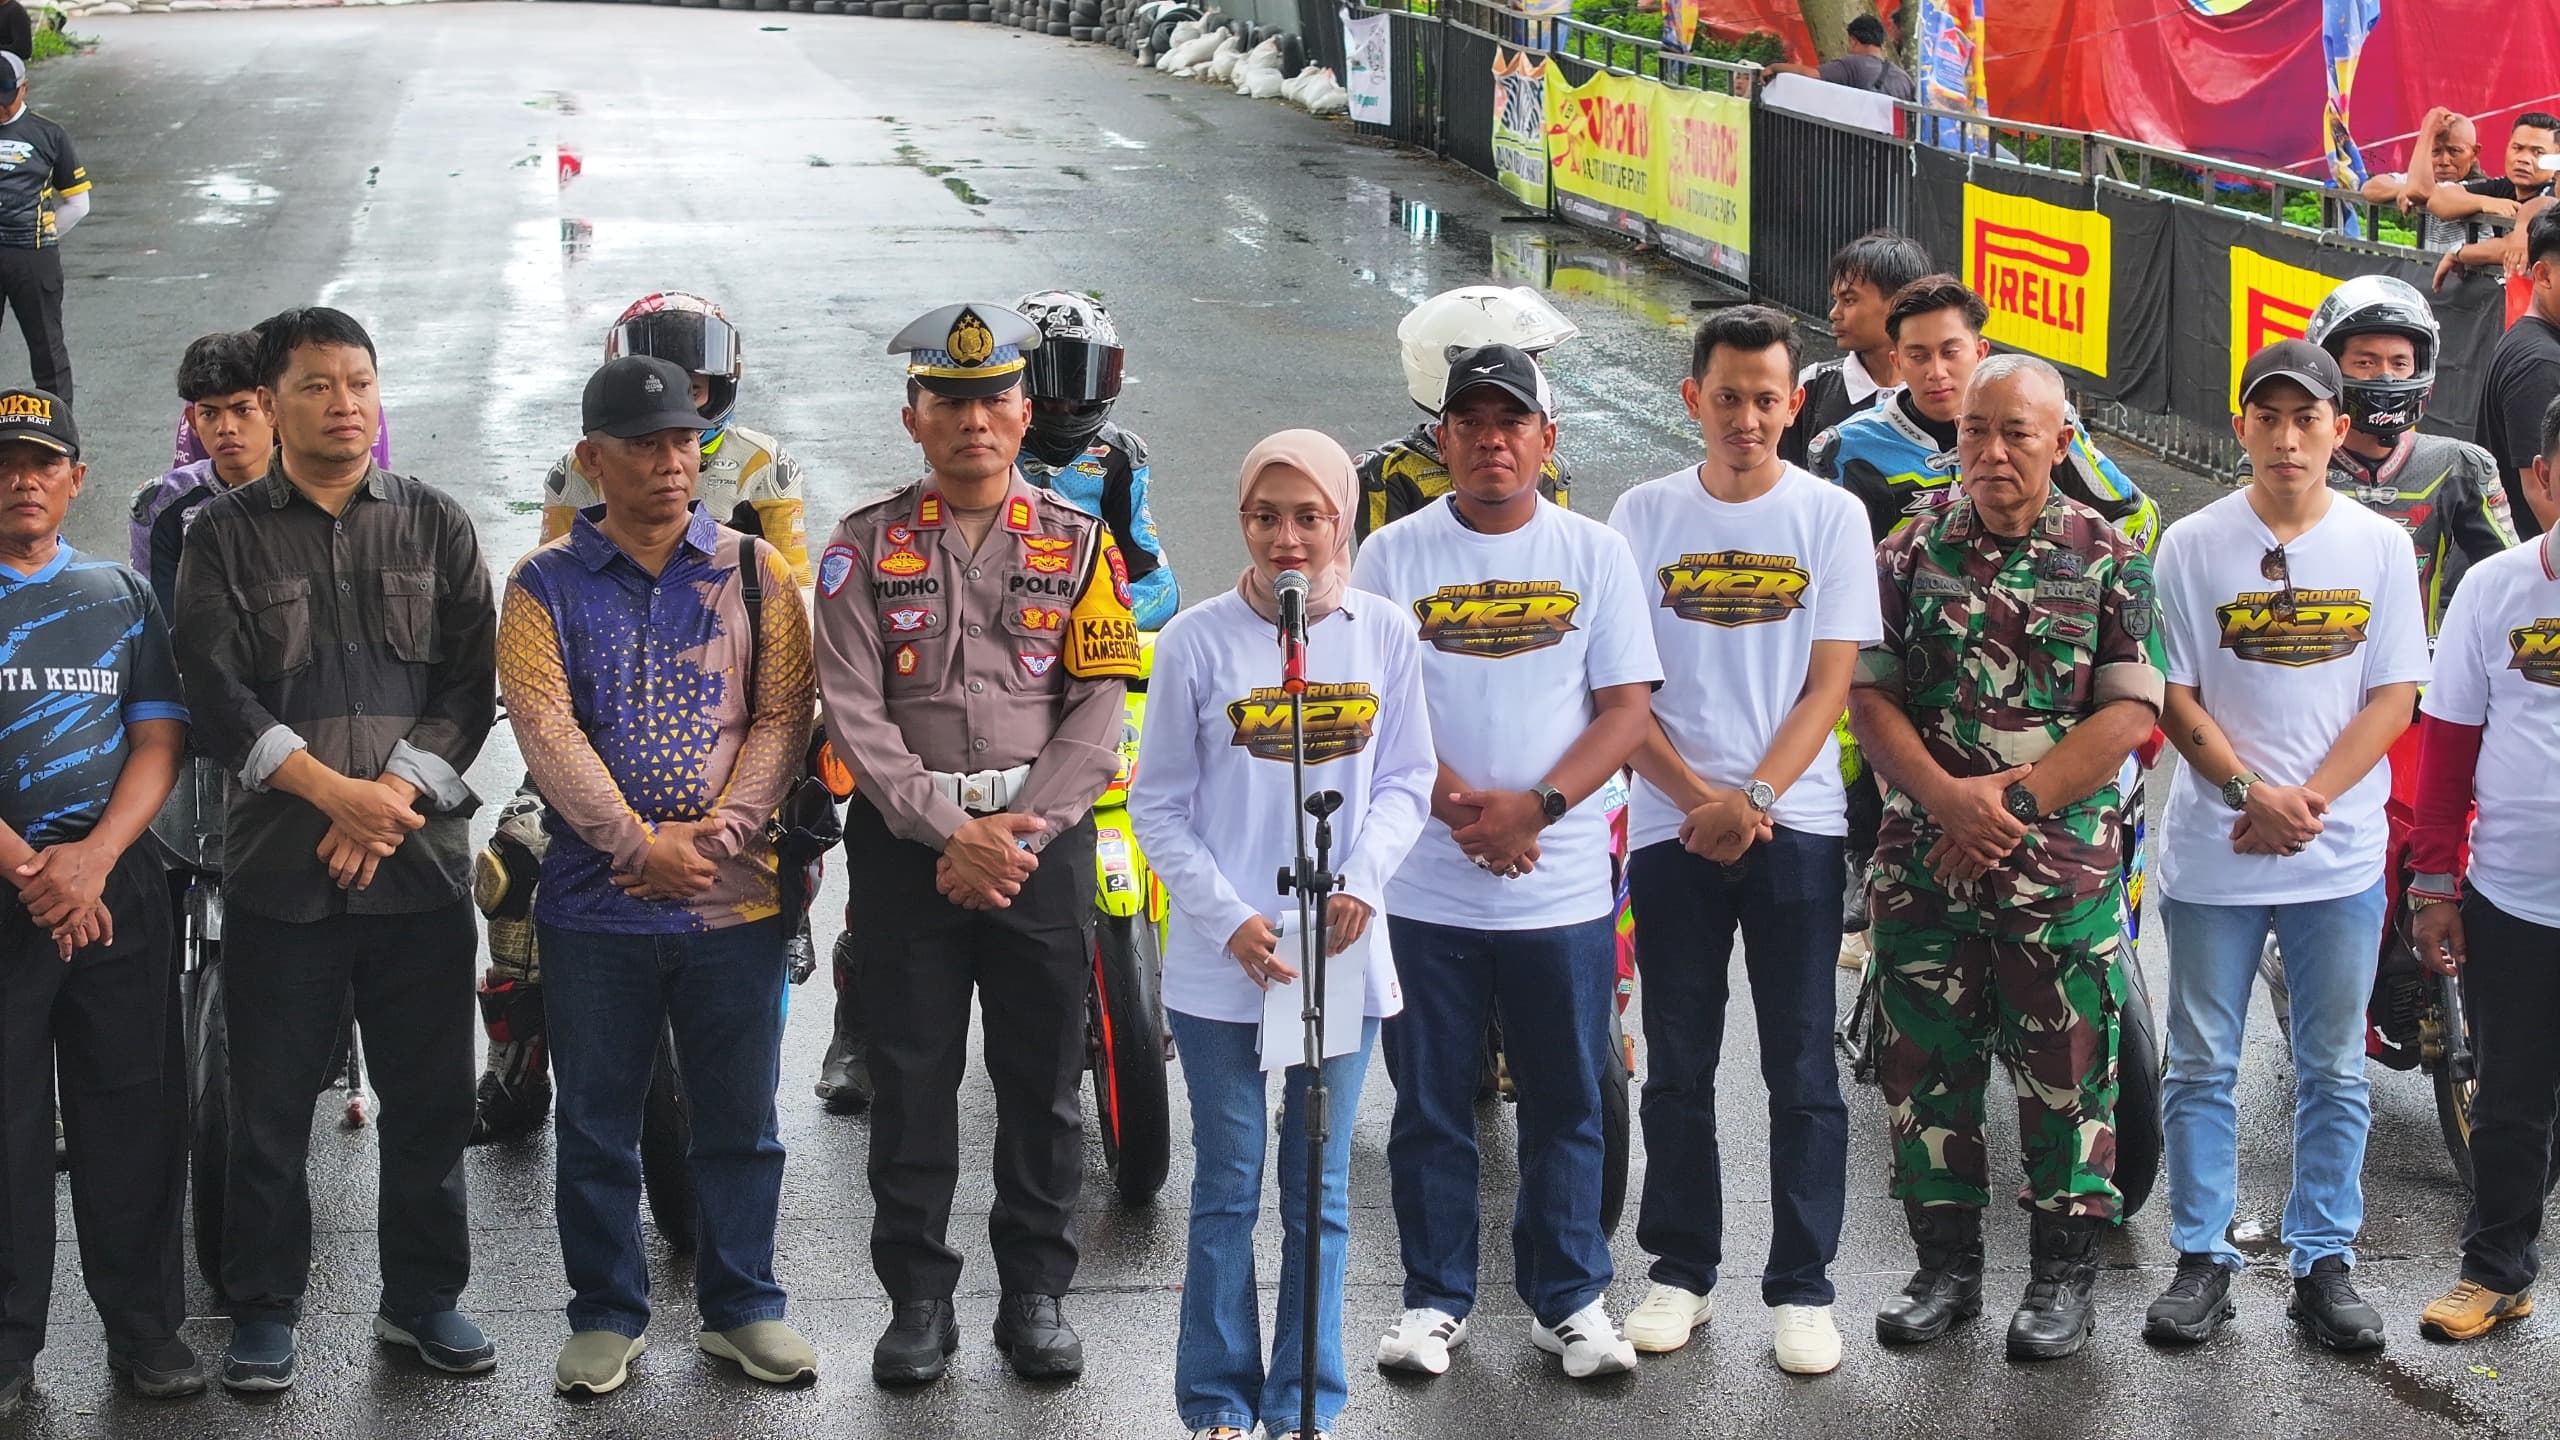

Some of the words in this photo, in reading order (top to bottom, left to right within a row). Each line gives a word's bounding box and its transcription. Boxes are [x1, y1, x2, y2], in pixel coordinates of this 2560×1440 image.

[1974, 218, 2090, 334] PIRELLI
[1680, 554, 1729, 567] FINAL
[1733, 554, 1796, 568] ROUND
[873, 578, 939, 598] YUDHO
[1010, 575, 1076, 597] POLRI
[1438, 585, 1489, 598] FINAL
[1495, 581, 1560, 595] ROUND
[1661, 569, 1807, 608] MCR
[2238, 592, 2276, 605] FIN
[2294, 589, 2360, 602] ROUND
[1419, 595, 1580, 639] MCR
[2220, 605, 2371, 647] MCR
[0, 668, 37, 691] TA
[45, 668, 119, 695] KEDIRI
[1306, 683, 1371, 698] ROUND
[1232, 700, 1377, 744] MCR
